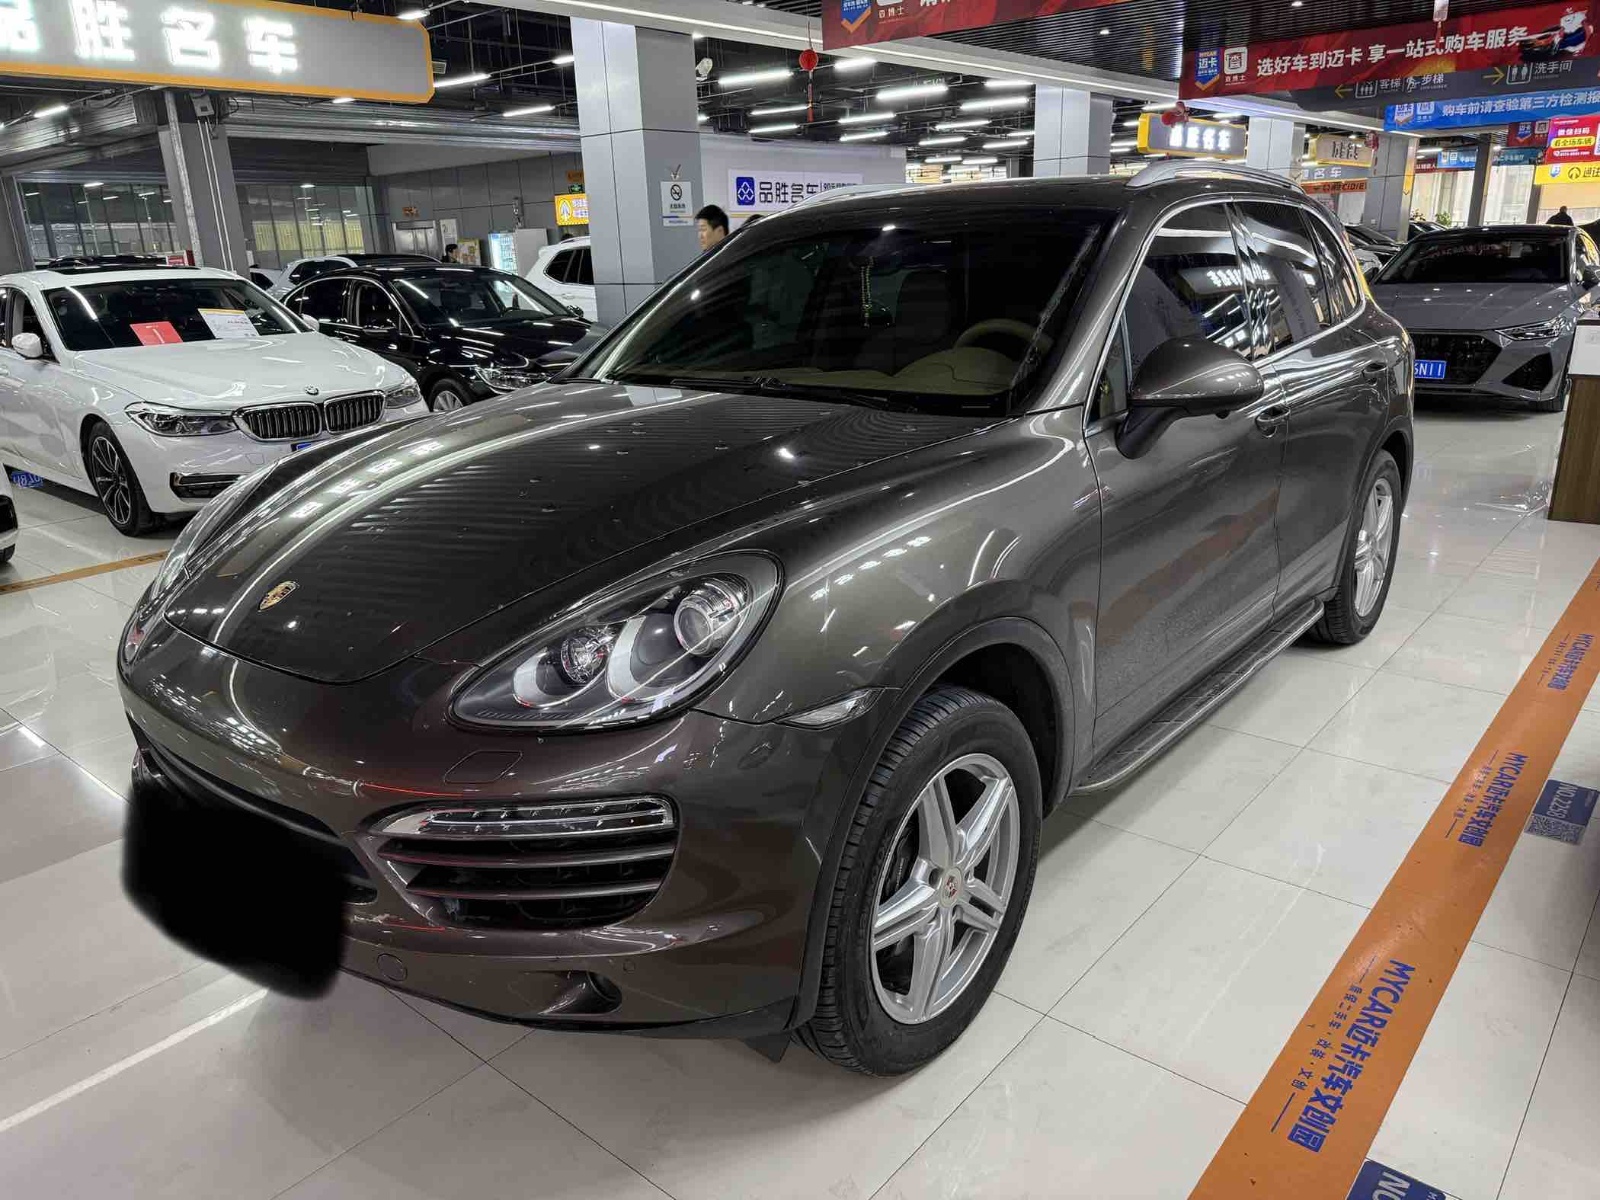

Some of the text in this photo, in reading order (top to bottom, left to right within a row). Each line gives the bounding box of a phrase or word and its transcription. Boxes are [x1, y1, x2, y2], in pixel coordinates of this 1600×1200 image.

[1198, 57, 1217, 69] 迈卡
[1257, 26, 1529, 76] 选好车到迈卡 享一站式购车服务
[1535, 60, 1573, 74] 洗手间
[1442, 91, 1600, 117] 购车前请查验第三方检测报
[759, 181, 819, 203] 品胜名车
[1287, 959, 1415, 1152] MYCAR迈卡汽车文创园
